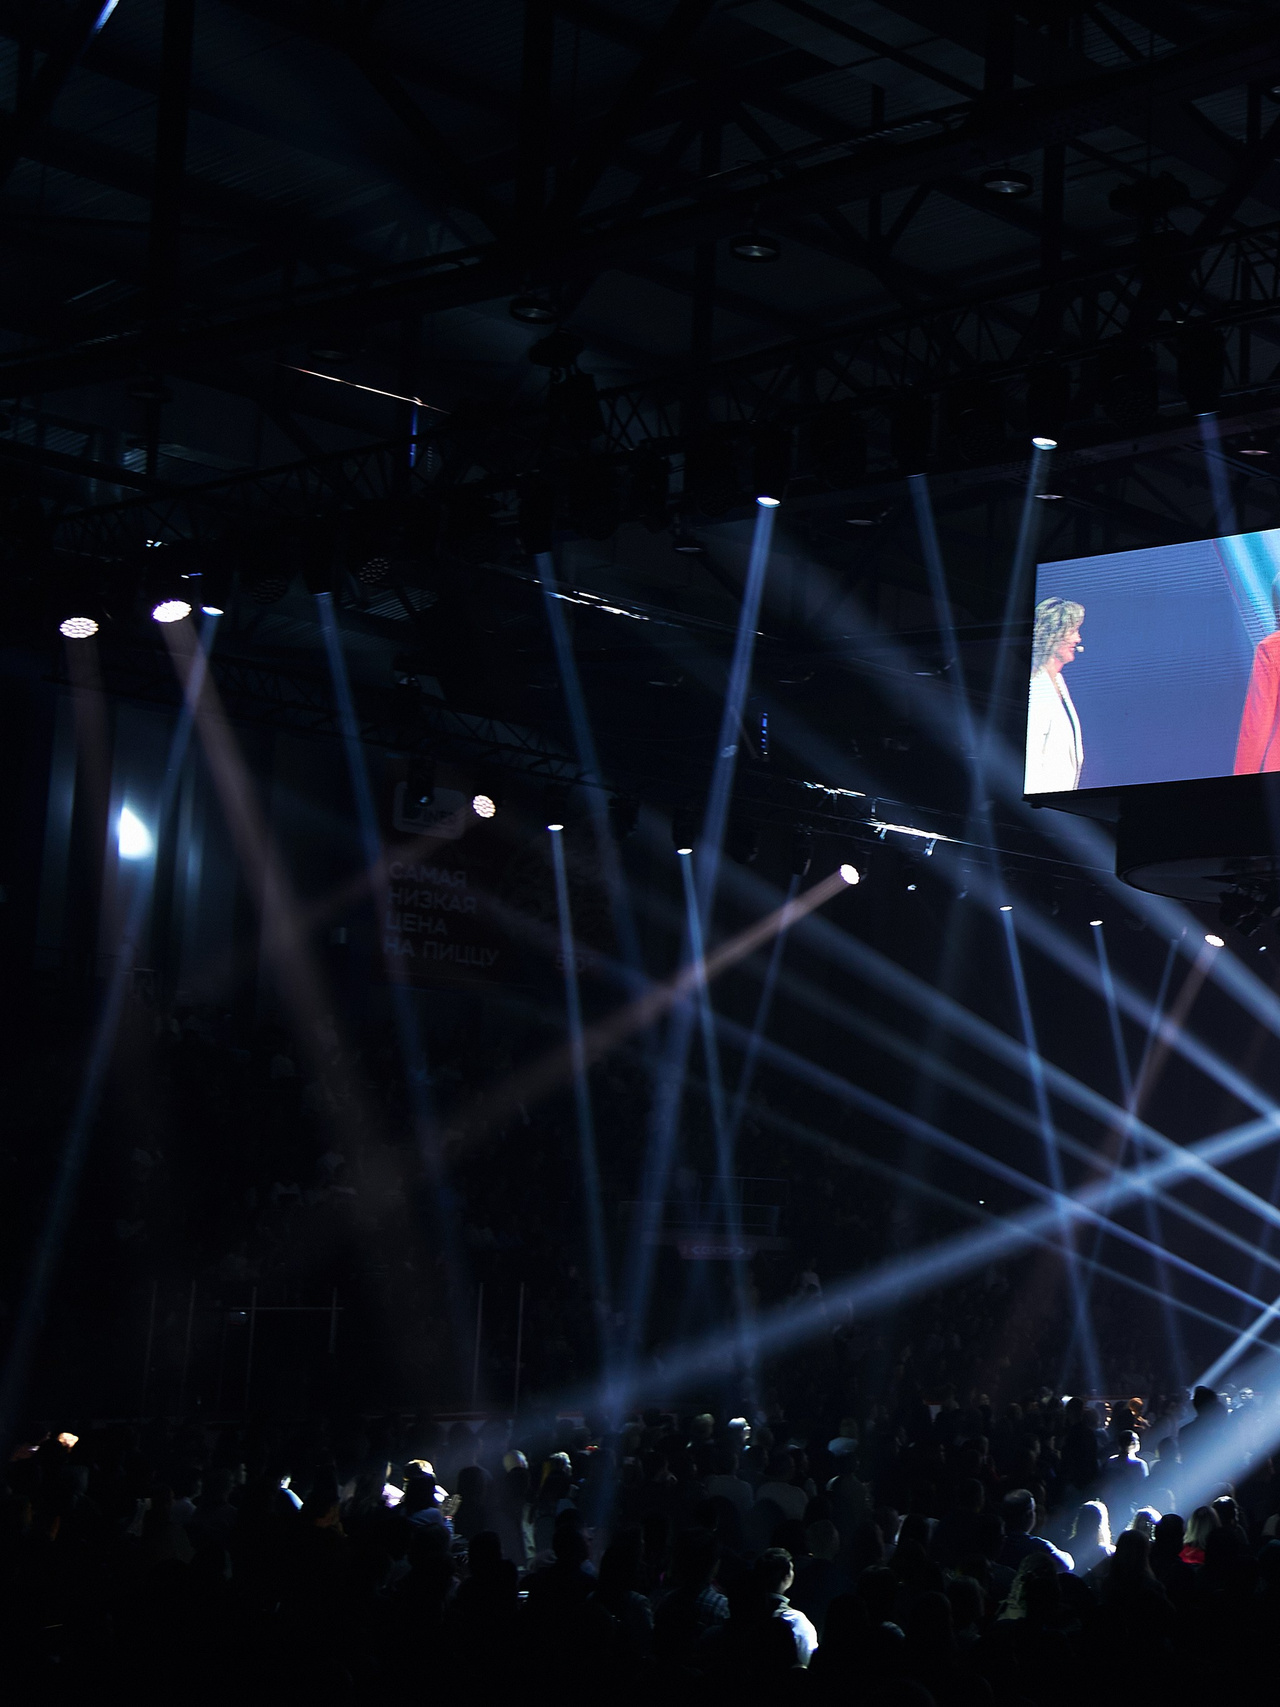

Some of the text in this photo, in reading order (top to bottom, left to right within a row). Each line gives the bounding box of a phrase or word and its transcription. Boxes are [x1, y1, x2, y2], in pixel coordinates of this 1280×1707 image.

[388, 861, 467, 888] САМАЯ
[387, 888, 477, 914] НИЗКАЯ
[385, 912, 448, 936] ЦЕНА
[384, 935, 499, 968] НА ПИЦЦУ
